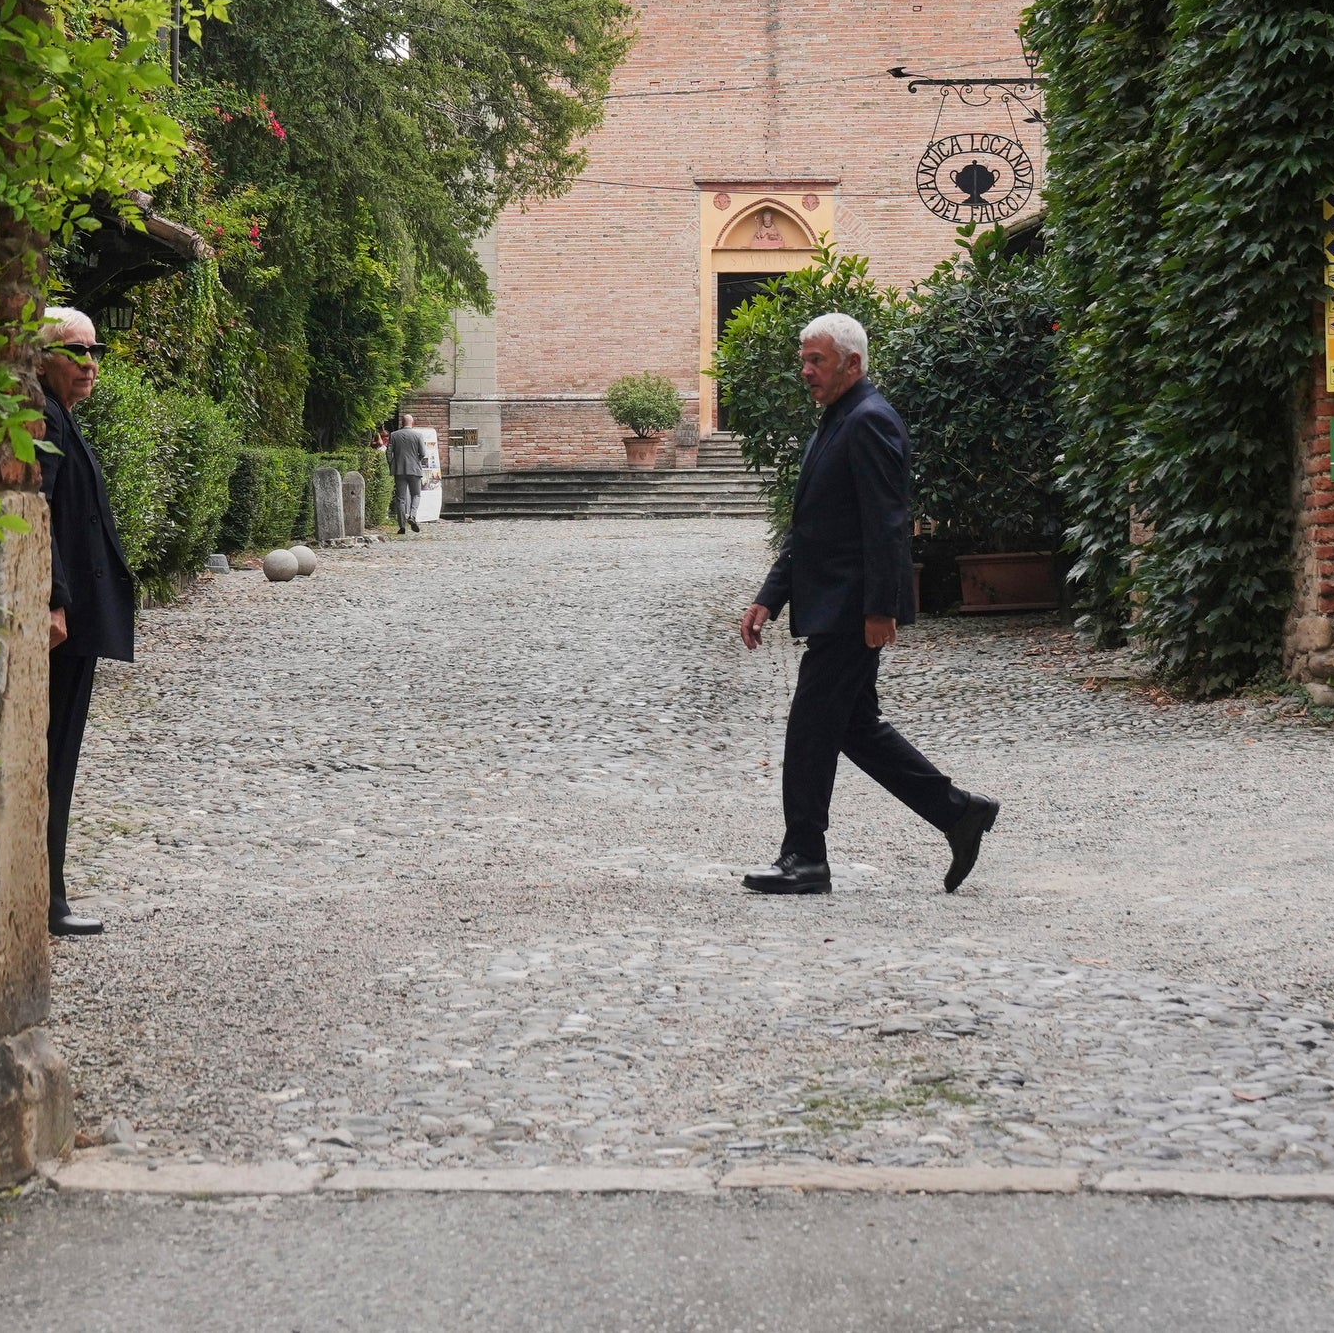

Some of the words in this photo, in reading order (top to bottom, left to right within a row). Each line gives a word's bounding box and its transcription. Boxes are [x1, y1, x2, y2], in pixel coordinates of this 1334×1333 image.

[919, 136, 962, 190] ANTICA
[971, 135, 1032, 190] LOCANDA
[932, 197, 961, 220] DEL
[971, 196, 1020, 223] FALCO
